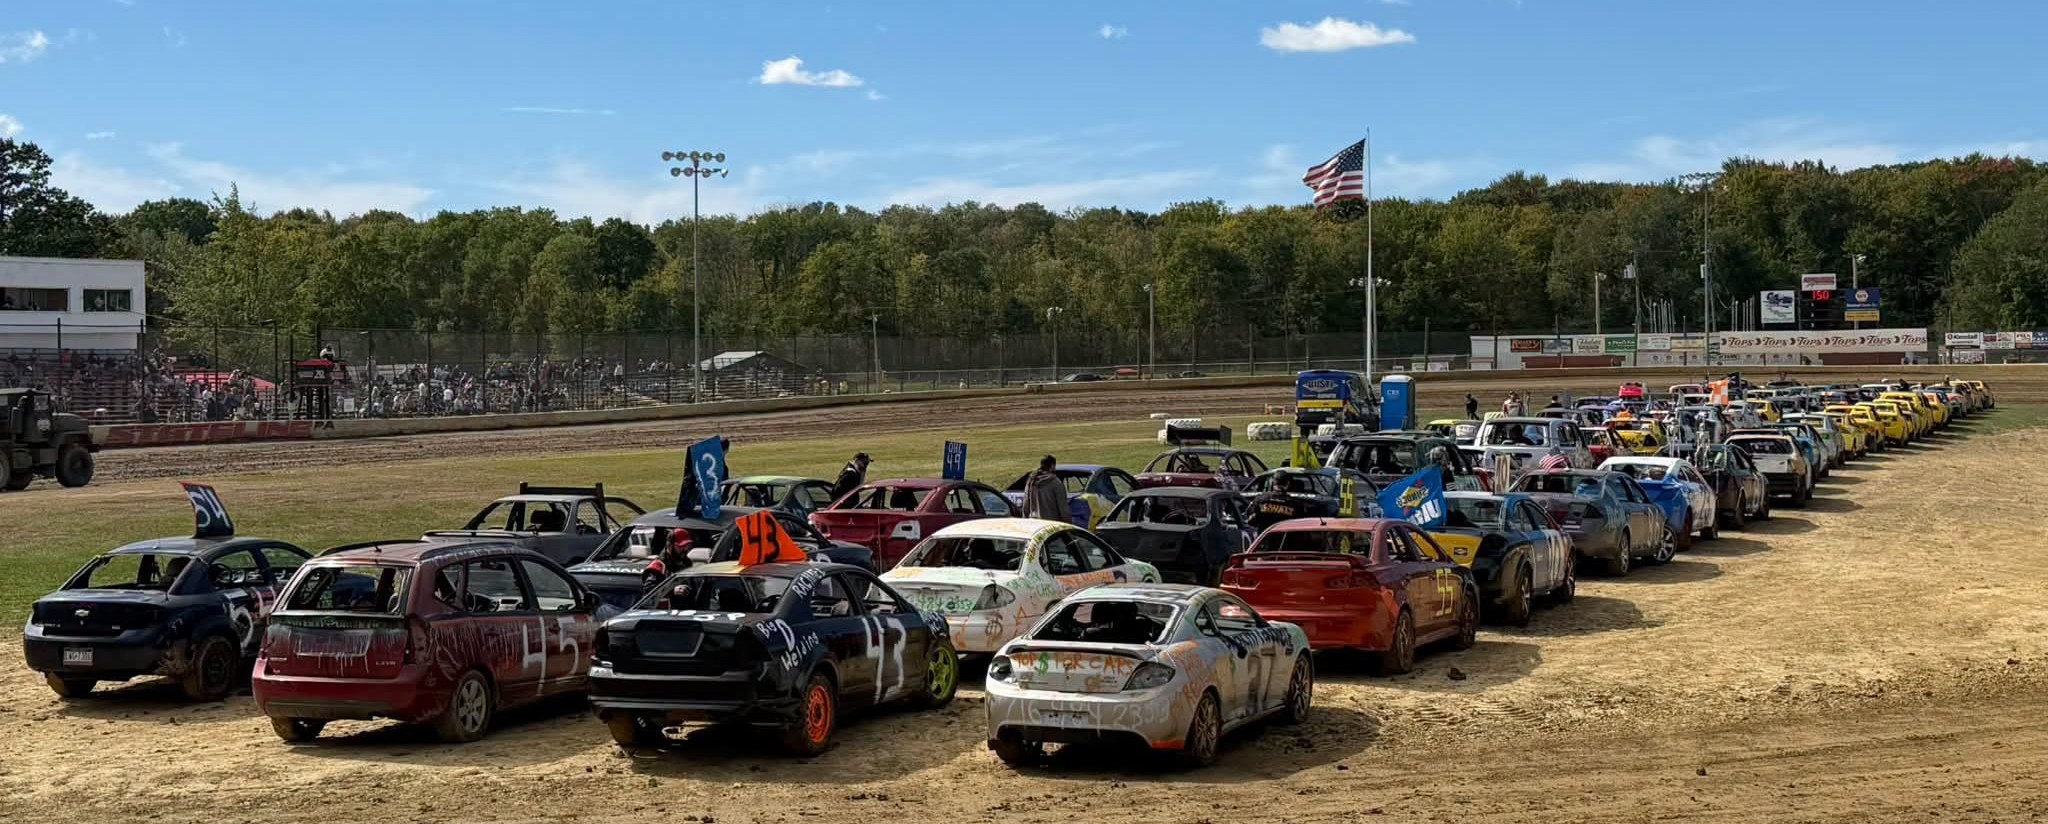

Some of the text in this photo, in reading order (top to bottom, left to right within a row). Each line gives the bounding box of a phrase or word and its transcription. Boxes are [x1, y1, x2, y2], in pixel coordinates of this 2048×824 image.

[1813, 290, 1830, 300] 150
[946, 453, 961, 472] 49
[1339, 477, 1353, 514] 55
[746, 512, 780, 564] 43
[1433, 567, 1454, 617] 55
[523, 616, 578, 696] 45
[775, 619, 796, 651] D
[781, 630, 820, 672] Welding
[861, 616, 907, 704] 43
